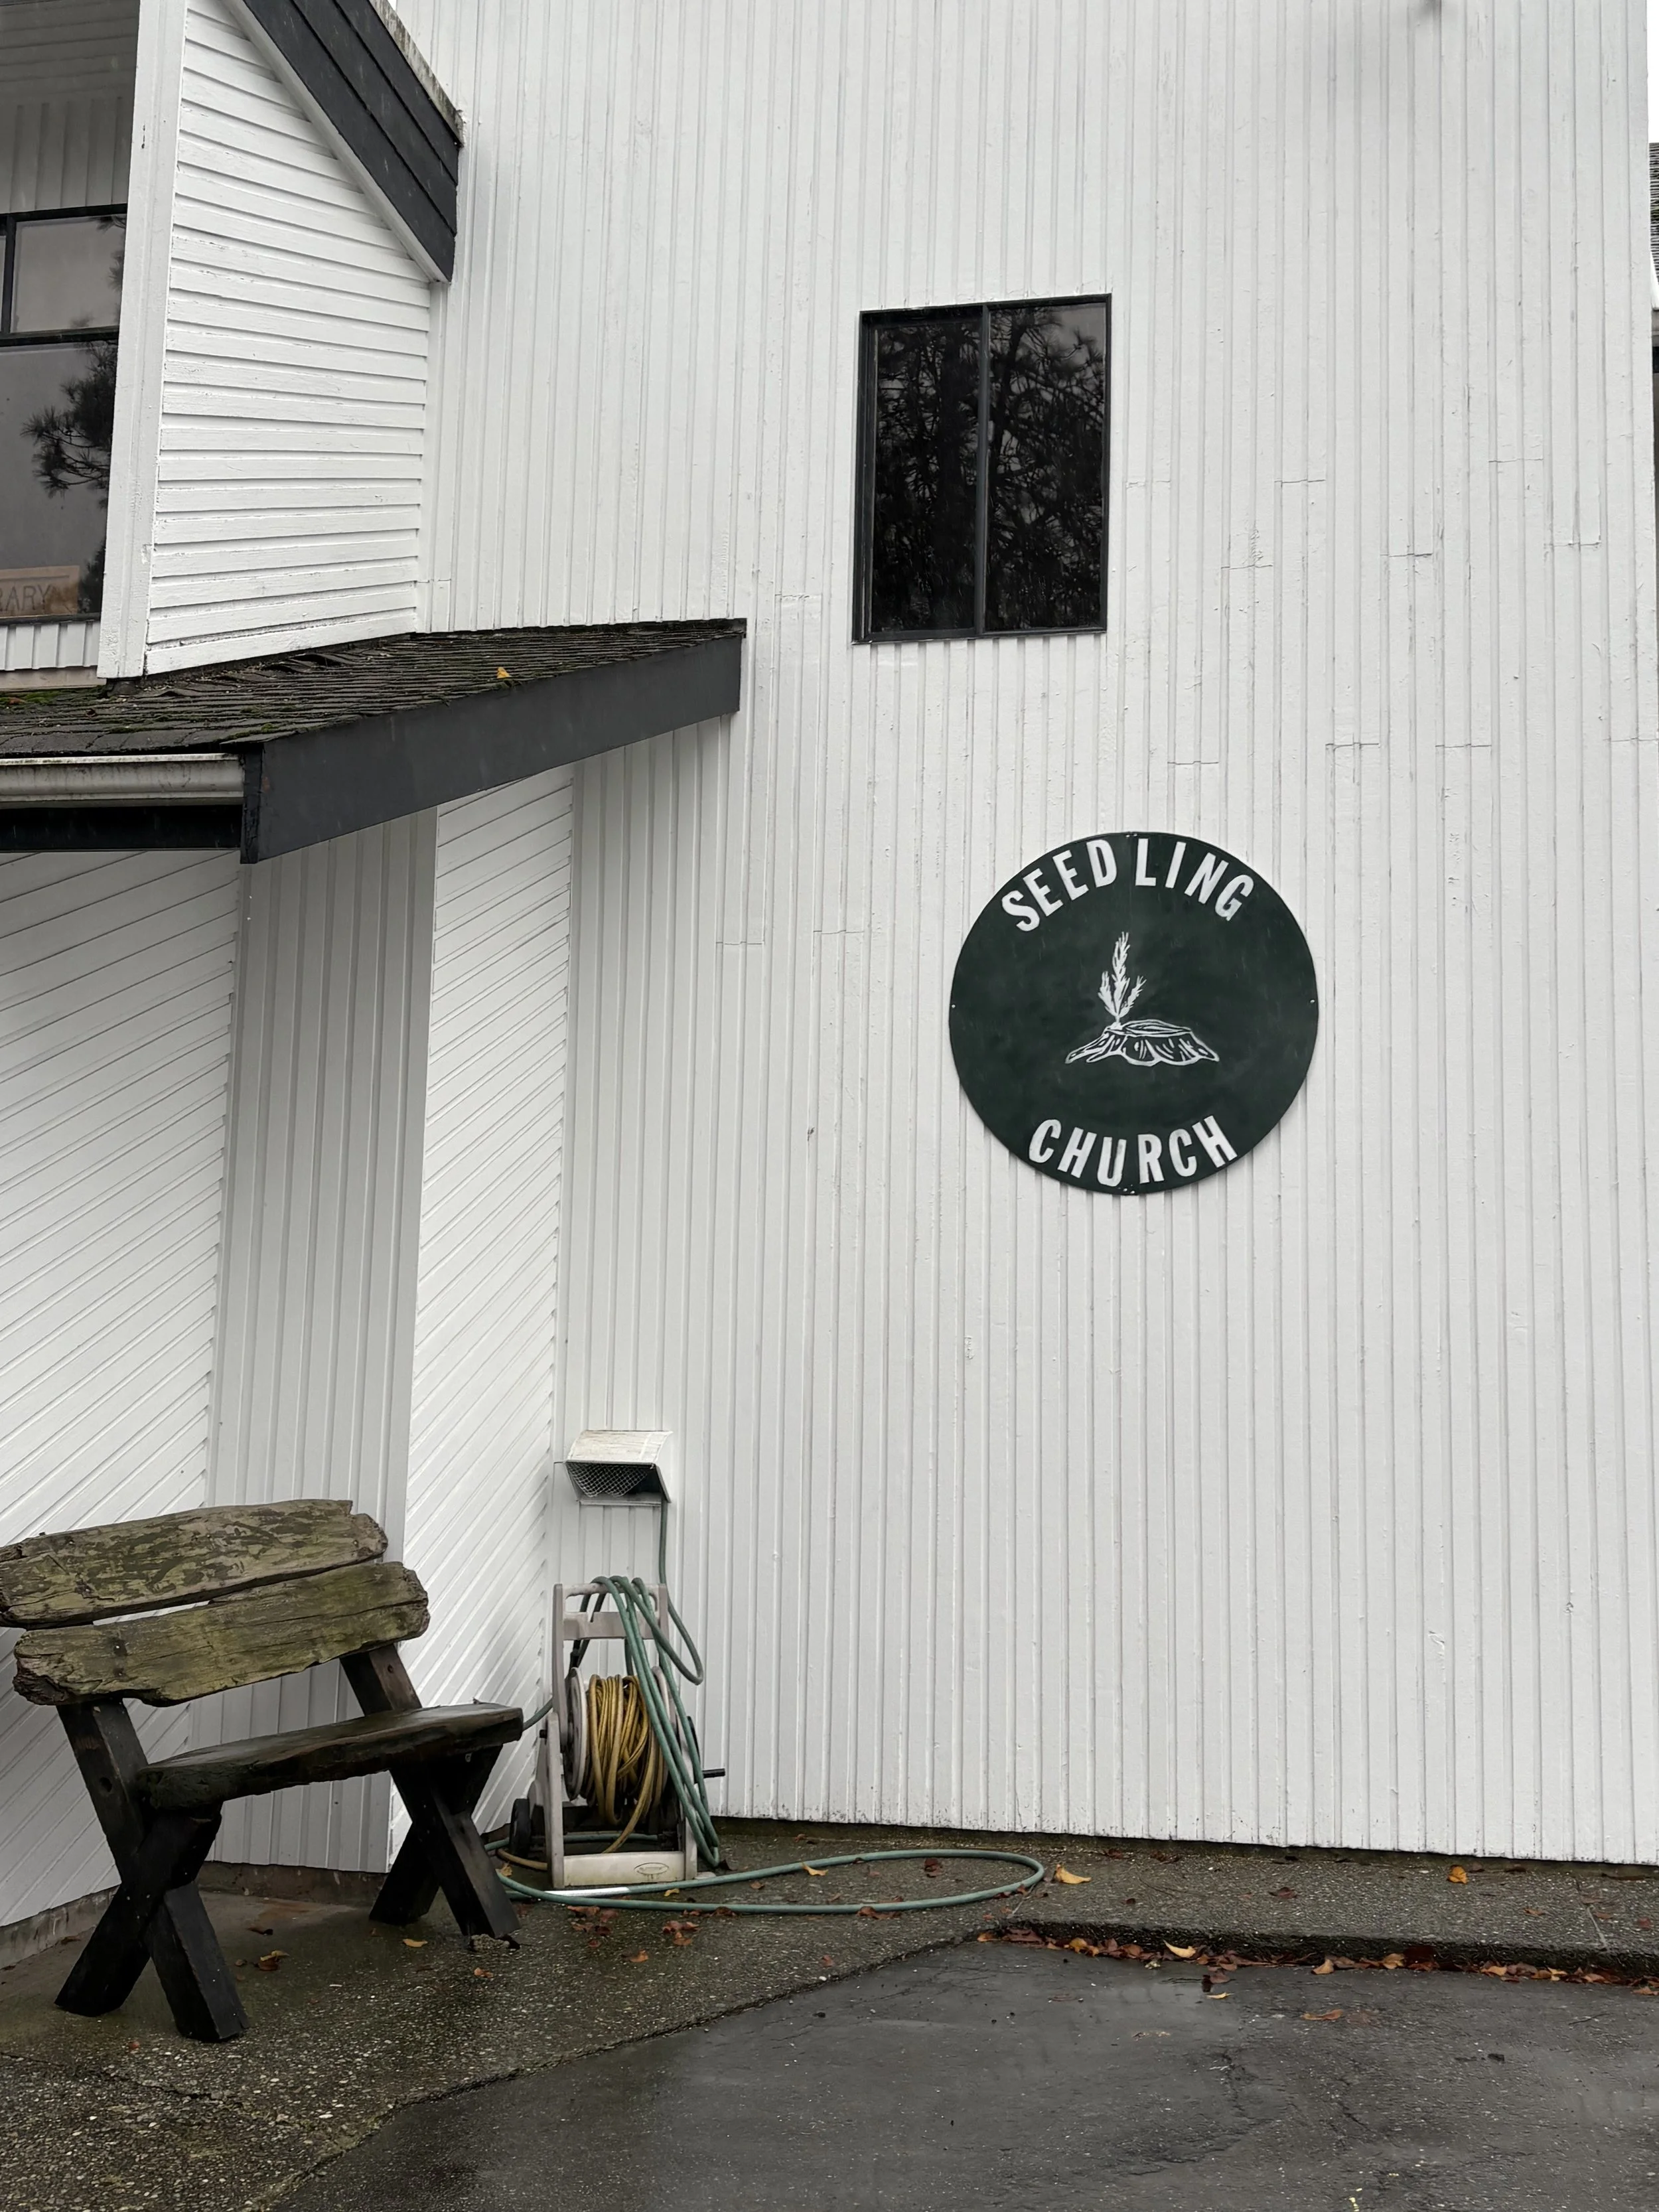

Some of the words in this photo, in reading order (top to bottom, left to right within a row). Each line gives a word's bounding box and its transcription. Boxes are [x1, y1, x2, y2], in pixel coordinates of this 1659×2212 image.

[0, 585, 50, 611] ARY
[1001, 838, 1254, 932] SEEDLING
[1029, 1115, 1238, 1187] CHURCH
